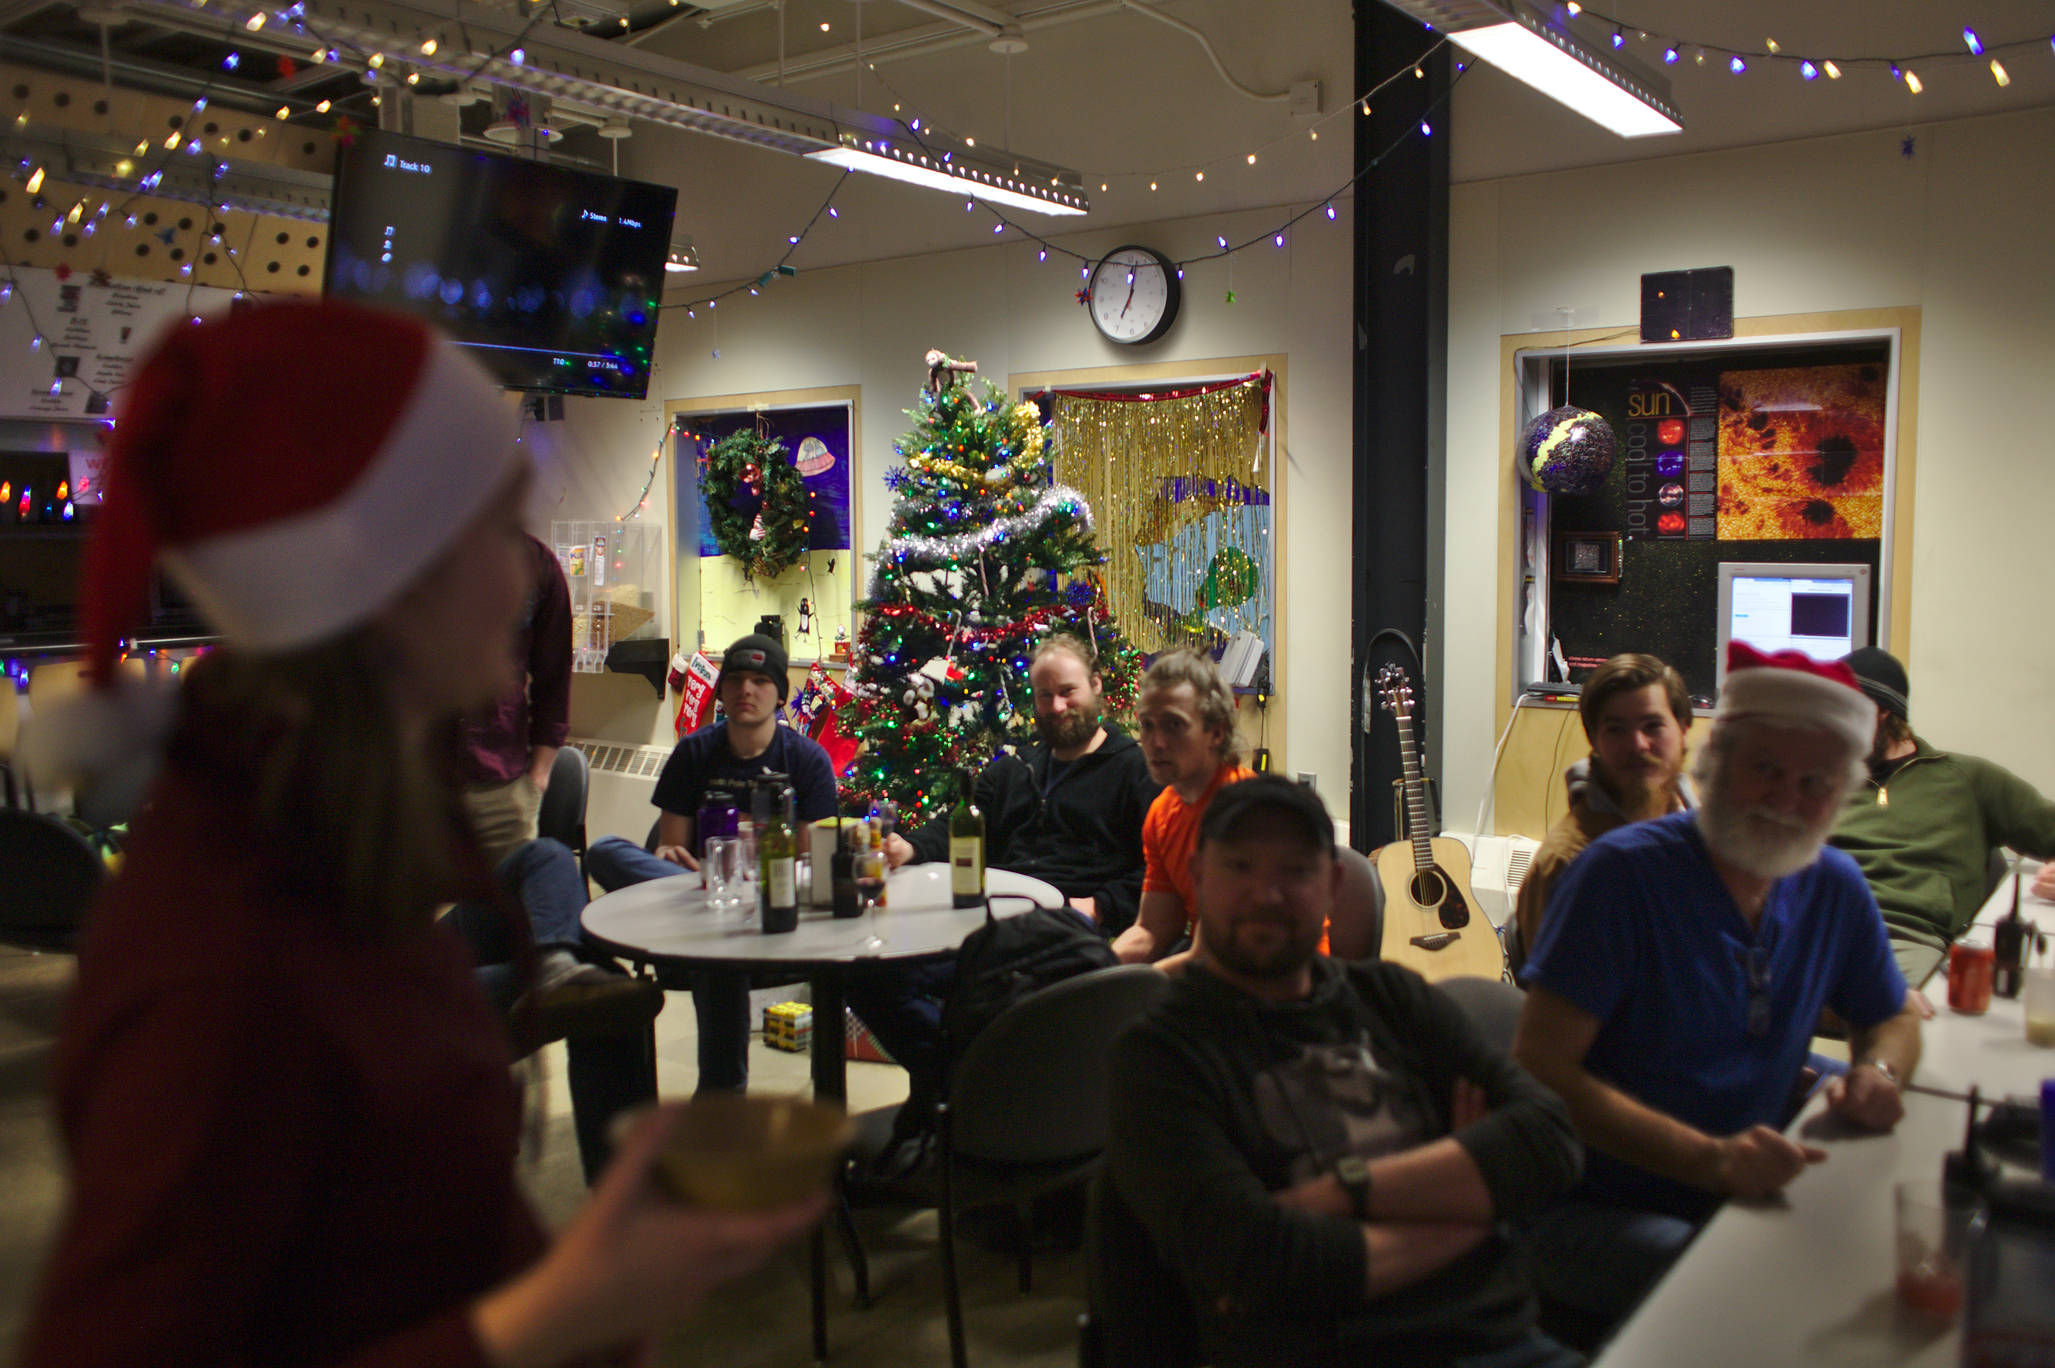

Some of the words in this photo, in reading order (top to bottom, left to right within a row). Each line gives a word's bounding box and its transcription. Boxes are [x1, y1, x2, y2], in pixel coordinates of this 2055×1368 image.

[400, 160, 418, 171] Track
[420, 163, 431, 173] 10
[590, 211, 608, 222] Stereo
[1628, 392, 1670, 416] sun
[1627, 423, 1653, 466] cool
[1627, 473, 1650, 493] to
[1627, 500, 1653, 535] hot
